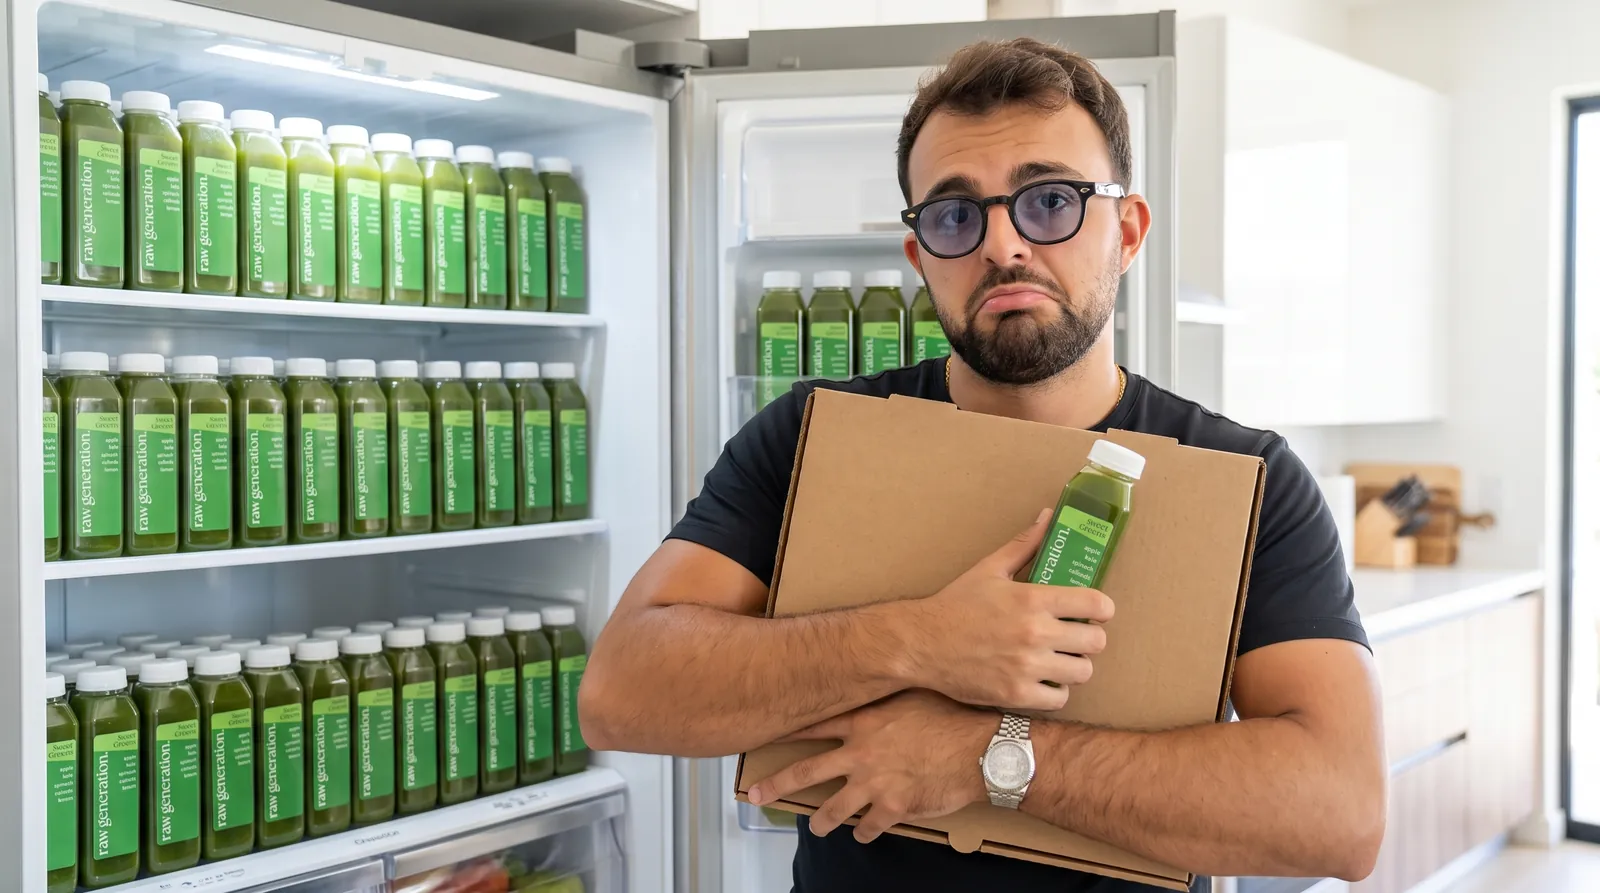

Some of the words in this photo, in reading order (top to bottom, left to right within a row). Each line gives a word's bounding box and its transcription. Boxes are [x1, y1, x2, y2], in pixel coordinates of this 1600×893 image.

[81, 159, 96, 234] generation.
[142, 167, 157, 241] generation.
[197, 174, 212, 246] generation.
[252, 185, 265, 253] generation.
[301, 191, 314, 257] generation.
[84, 237, 93, 262] raw
[145, 243, 154, 267] raw
[200, 248, 209, 272] raw
[254, 255, 262, 279] raw
[304, 259, 312, 282] raw
[865, 337, 874, 376] ration.
[79, 431, 95, 505] generation.
[136, 431, 152, 504] generation.
[191, 431, 207, 502] generation.
[249, 430, 263, 499] generation.
[304, 429, 317, 497] generation.
[82, 508, 91, 533] raw
[139, 507, 148, 531] raw
[194, 504, 203, 528] raw
[252, 501, 260, 524] raw
[1079, 523, 1107, 539] Greens
[1087, 519, 1109, 532] Sweet
[1038, 527, 1071, 584] neration.
[1084, 545, 1101, 555] apple
[1072, 560, 1094, 572] spinach
[53, 743, 73, 751] Sweet
[314, 715, 328, 782] generation.
[360, 707, 373, 773] generation.
[48, 751, 74, 759] Greens
[214, 729, 229, 801] generation.
[266, 723, 280, 793] generation.
[96, 752, 112, 826] generation.
[159, 741, 174, 813] generation.
[363, 775, 371, 797] raw
[269, 795, 278, 819] raw
[318, 784, 326, 807] raw
[218, 804, 227, 827] raw
[162, 816, 171, 841] raw
[99, 829, 108, 855] raw
